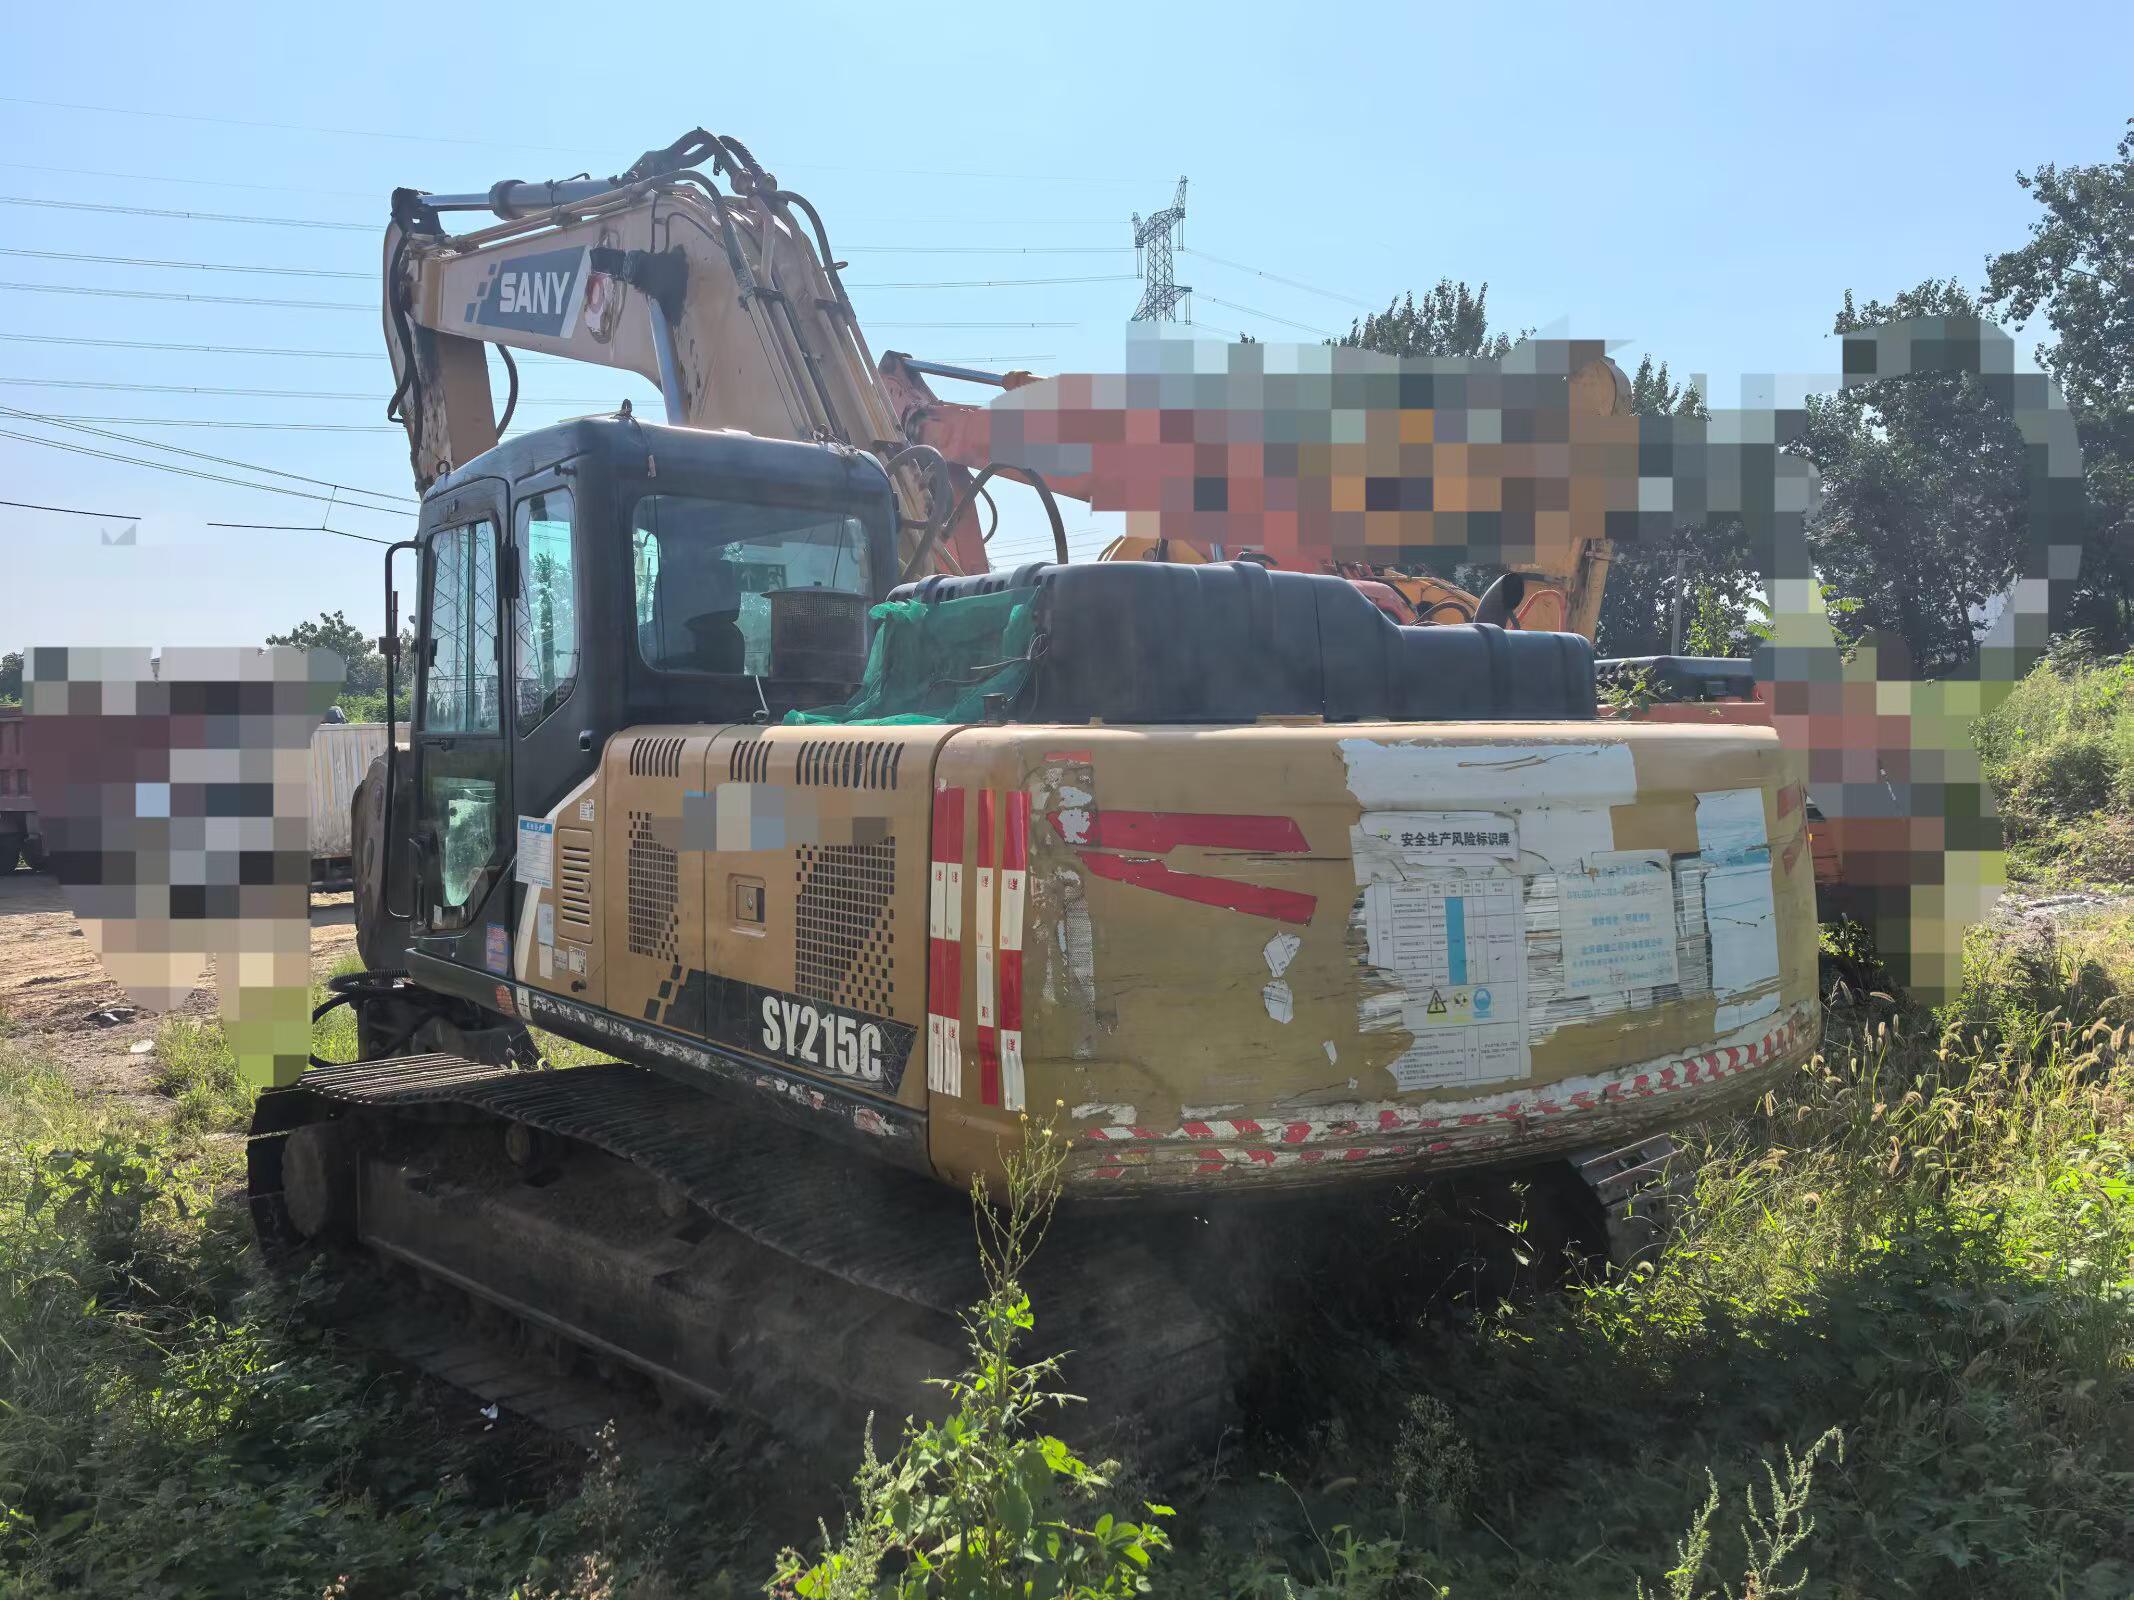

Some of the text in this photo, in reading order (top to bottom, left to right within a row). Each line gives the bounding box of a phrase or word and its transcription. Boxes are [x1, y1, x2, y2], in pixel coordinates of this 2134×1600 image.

[500, 271, 571, 314] SANY
[1401, 832, 1510, 847] 安全生产风险标识牌
[762, 995, 882, 1081] SY215C
